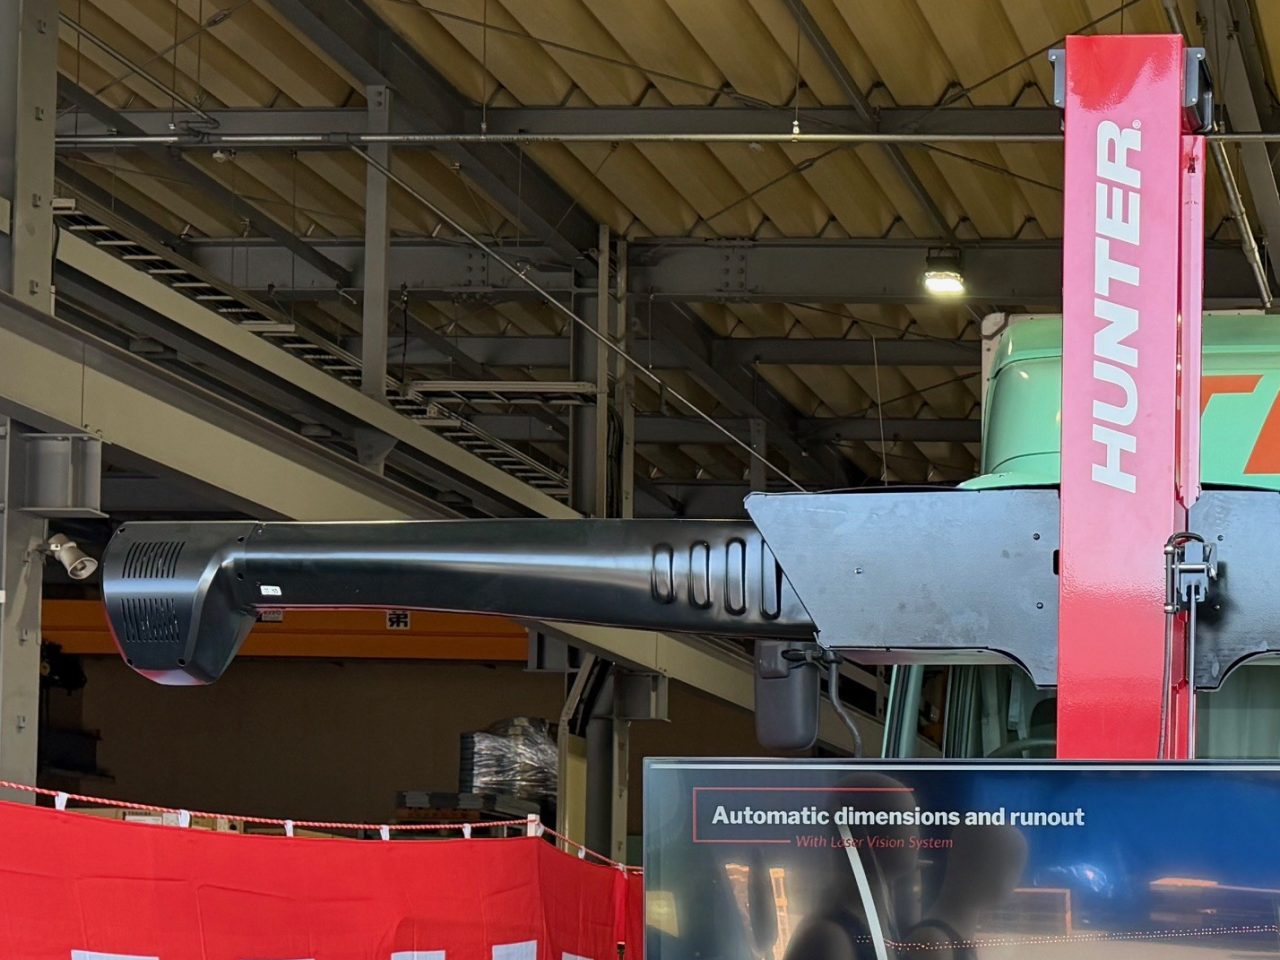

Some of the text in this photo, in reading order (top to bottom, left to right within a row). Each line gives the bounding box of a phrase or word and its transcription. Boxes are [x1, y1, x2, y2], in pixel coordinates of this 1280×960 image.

[1091, 119, 1143, 494] HUNTER
[711, 805, 1085, 826] Automatic dimensions and runout
[796, 834, 953, 850] With Laser Vision System
